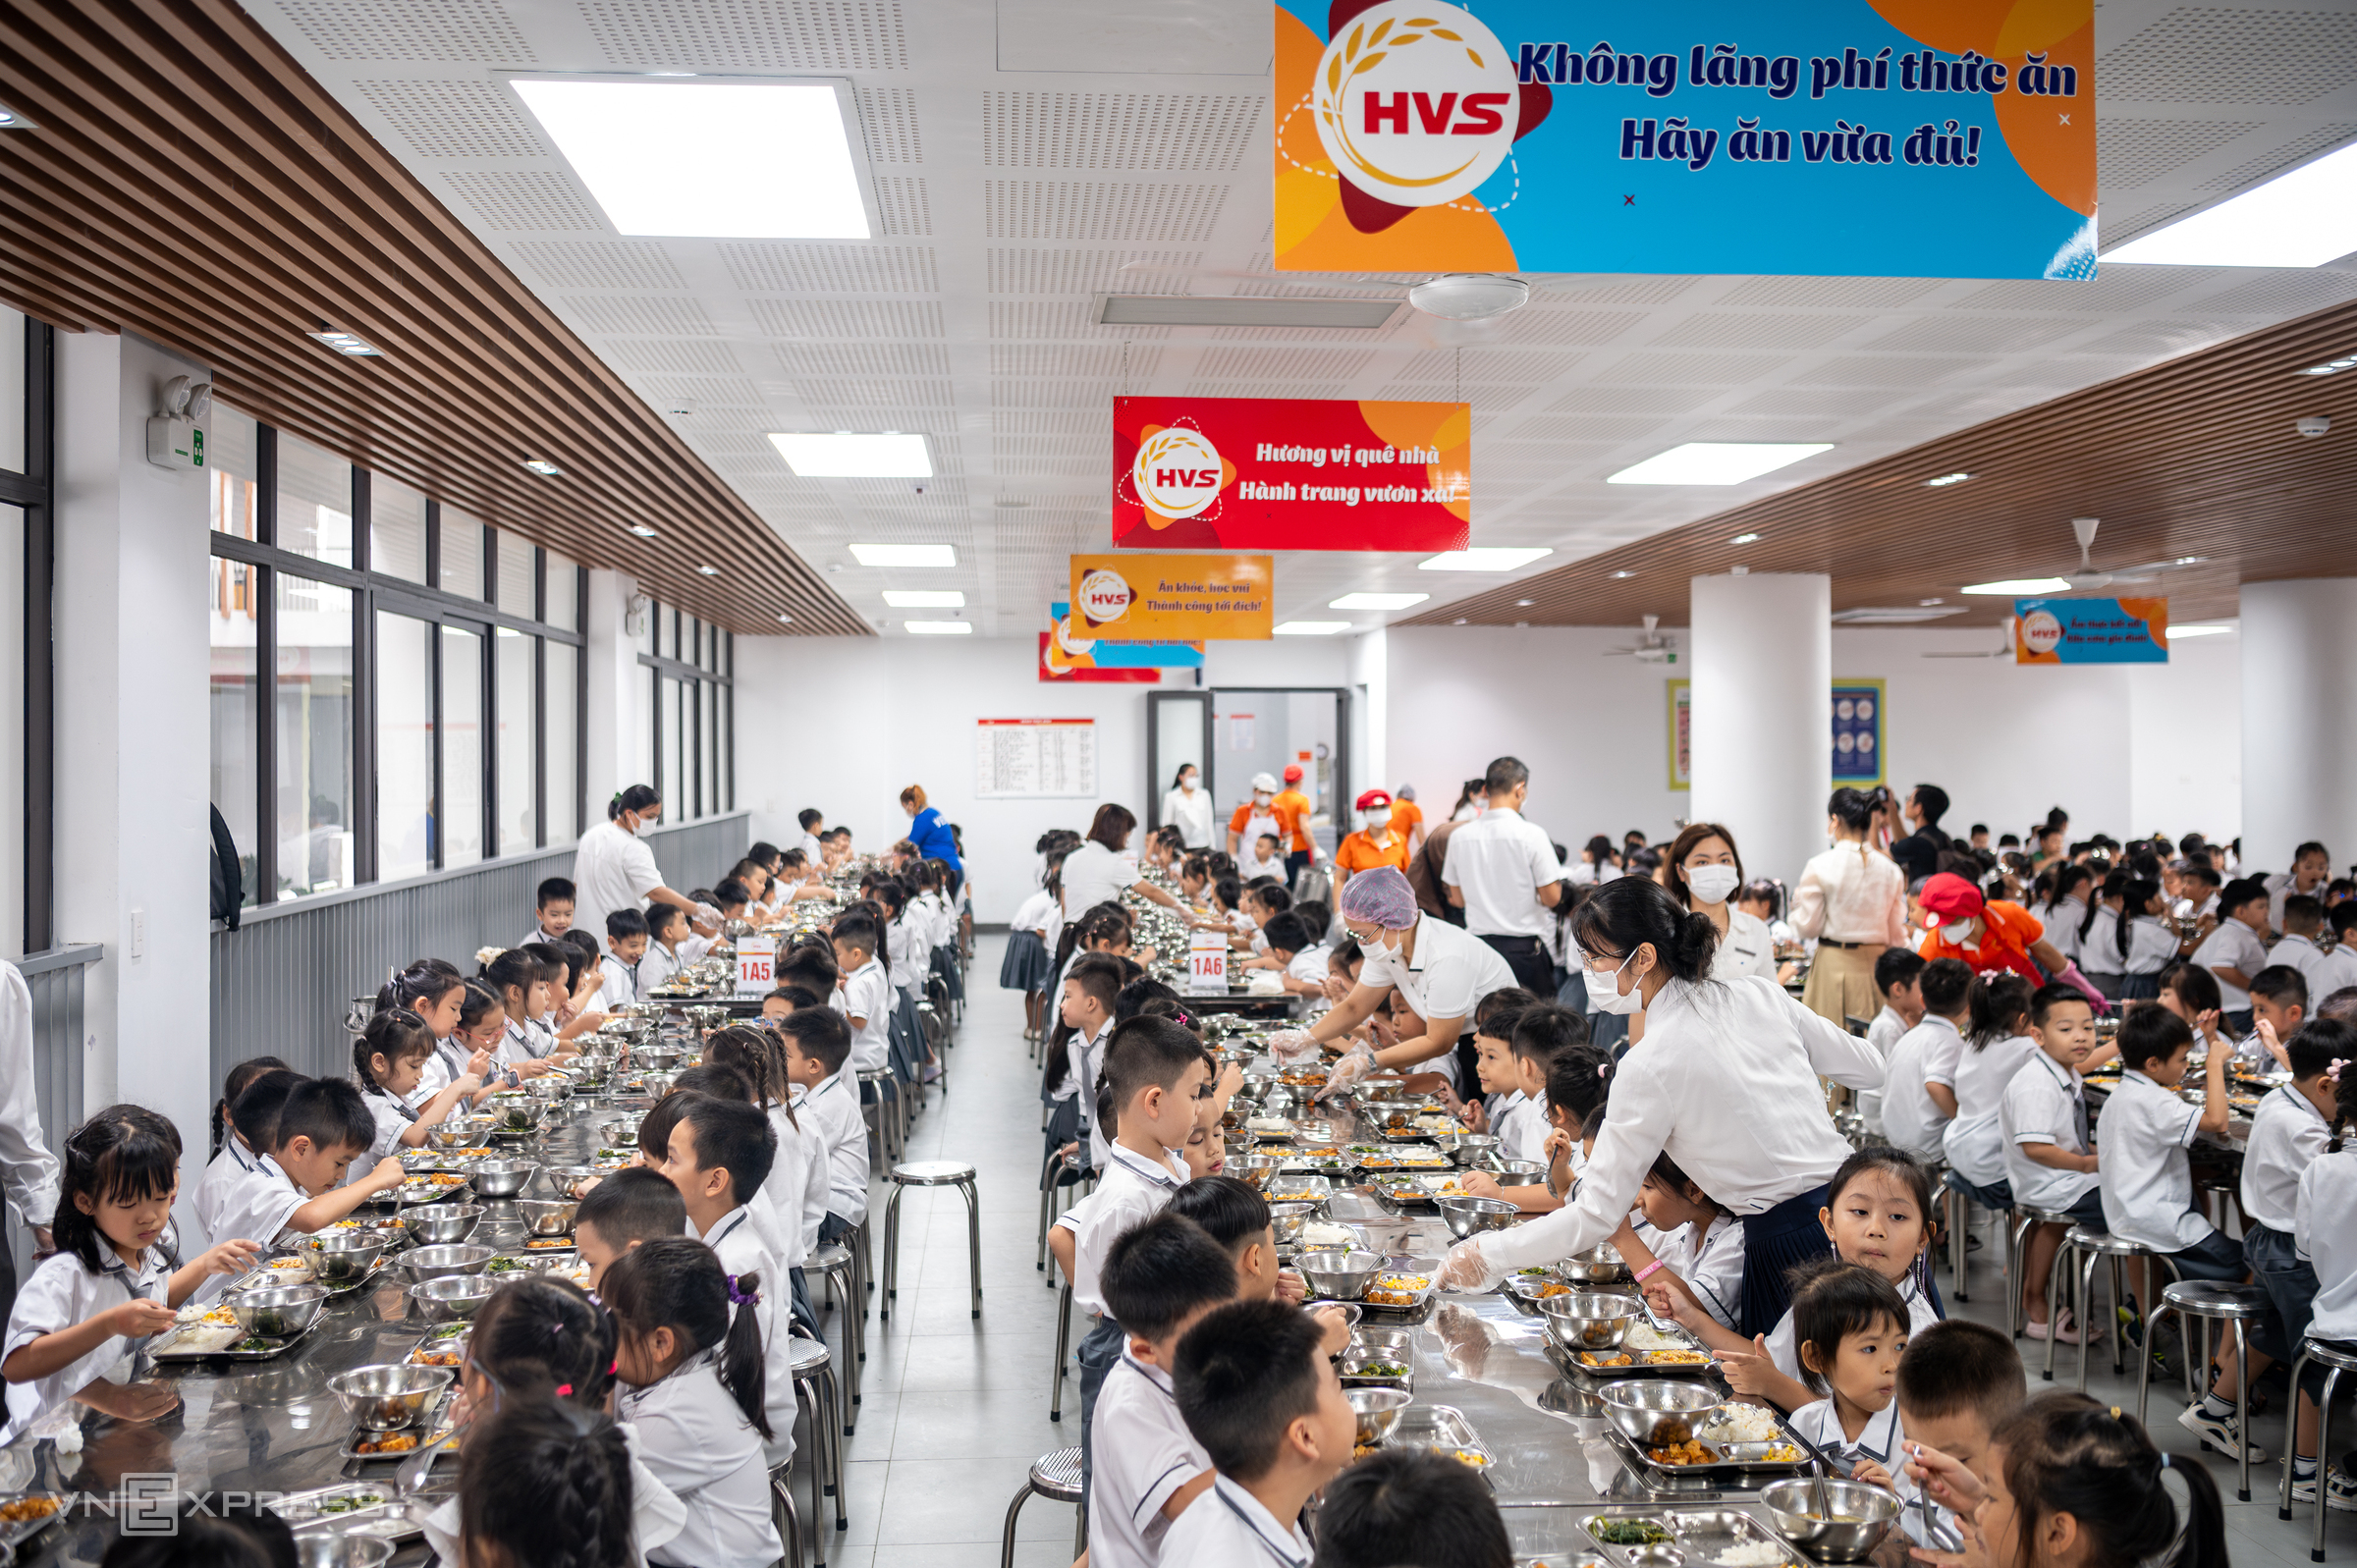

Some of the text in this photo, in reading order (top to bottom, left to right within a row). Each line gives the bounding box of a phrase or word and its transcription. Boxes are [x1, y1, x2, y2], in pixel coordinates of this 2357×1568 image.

[1518, 41, 2077, 100] Không lãng phí thức ăn
[1363, 91, 1510, 135] HVS
[1619, 116, 1982, 171] Hãy ăn vừa đủ!
[1256, 443, 1440, 468] Hương vị quê nhà
[1156, 468, 1221, 488] HVS
[1239, 480, 1455, 507] Hành trang vươn xa!
[1158, 579, 1250, 595] Ăn khỏe, học vui
[1091, 593, 1128, 606] HVS
[1146, 599, 1262, 614] Thành công tới đích!
[2032, 628, 2058, 639] HVS
[740, 962, 770, 981] 1A5
[1194, 957, 1223, 976] 1A6
